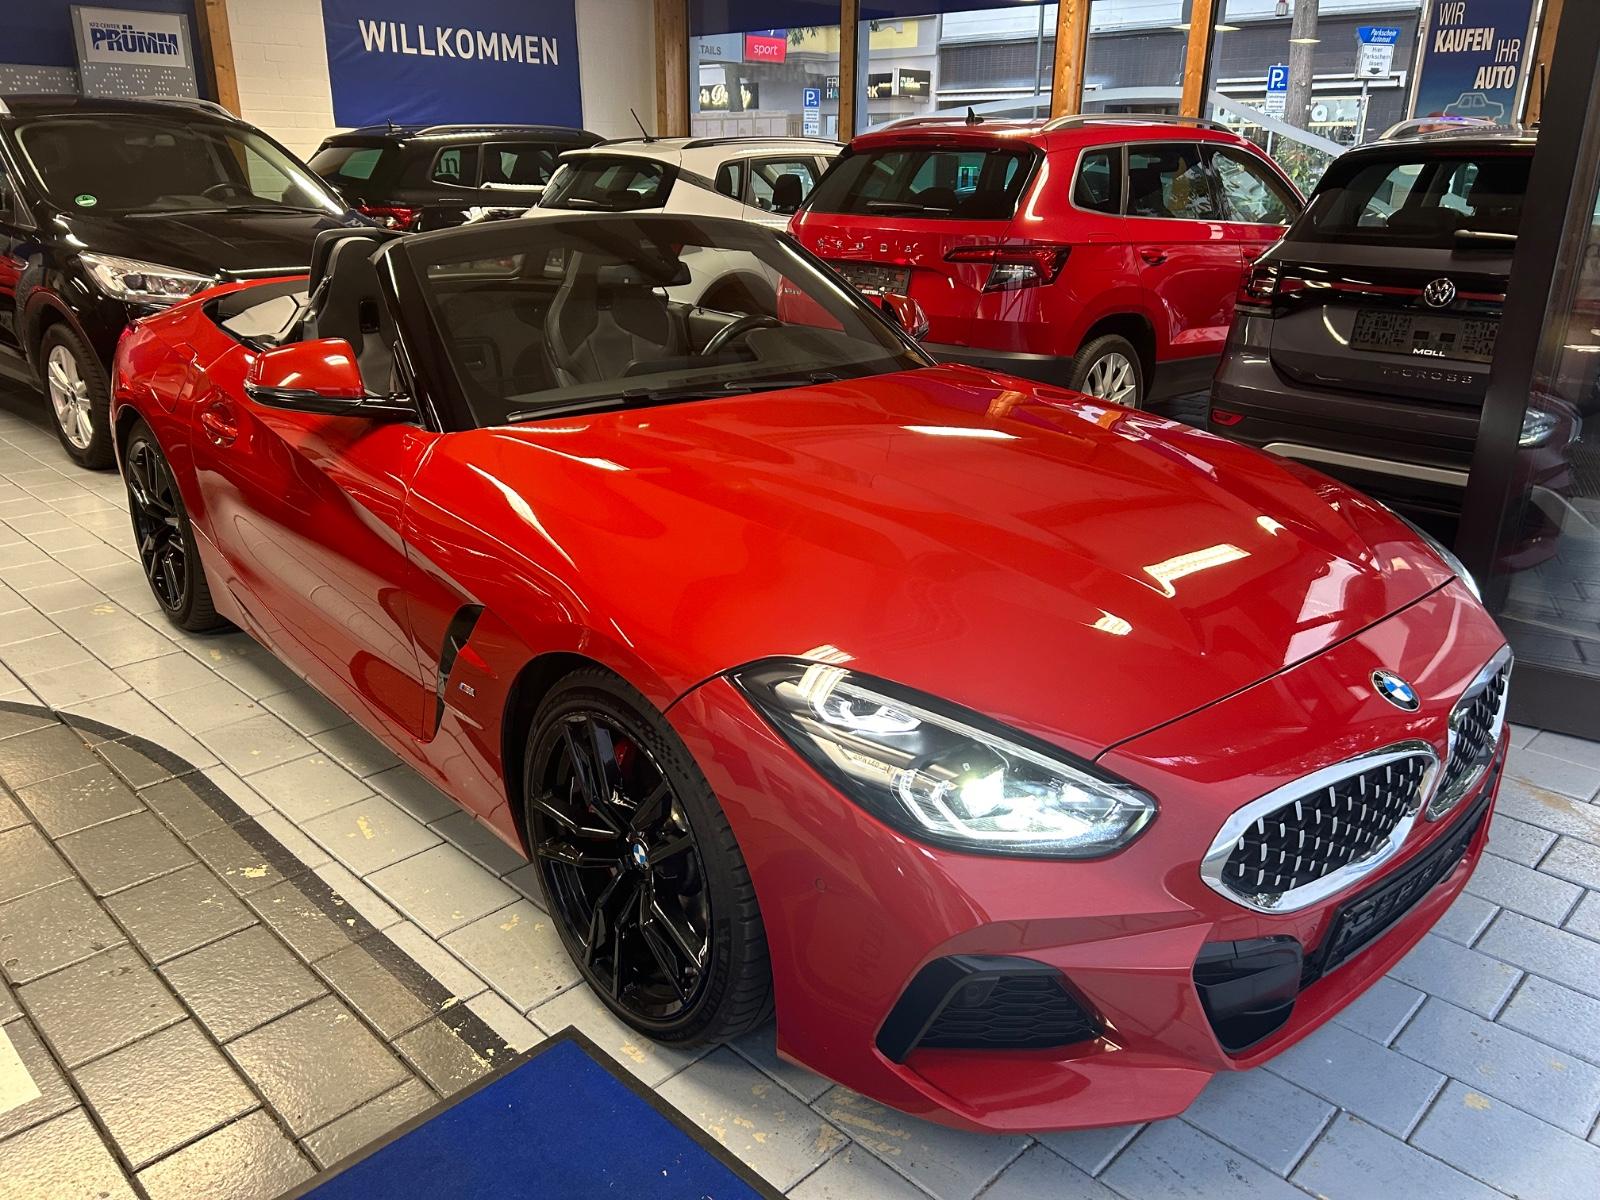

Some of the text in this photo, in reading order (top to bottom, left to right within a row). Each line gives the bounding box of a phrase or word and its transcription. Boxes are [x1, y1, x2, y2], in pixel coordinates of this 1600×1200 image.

[1439, 2, 1466, 26] WIR
[90, 25, 180, 55] PRÜMM
[358, 19, 559, 66] WILLKOMMEN
[753, 44, 779, 56] sport
[1434, 27, 1495, 53] KAUFEN
[1495, 38, 1521, 63] IHR
[1270, 69, 1285, 89] P
[1473, 65, 1517, 90] AUTO
[806, 91, 816, 106] P
[1412, 347, 1446, 357] MOLL
